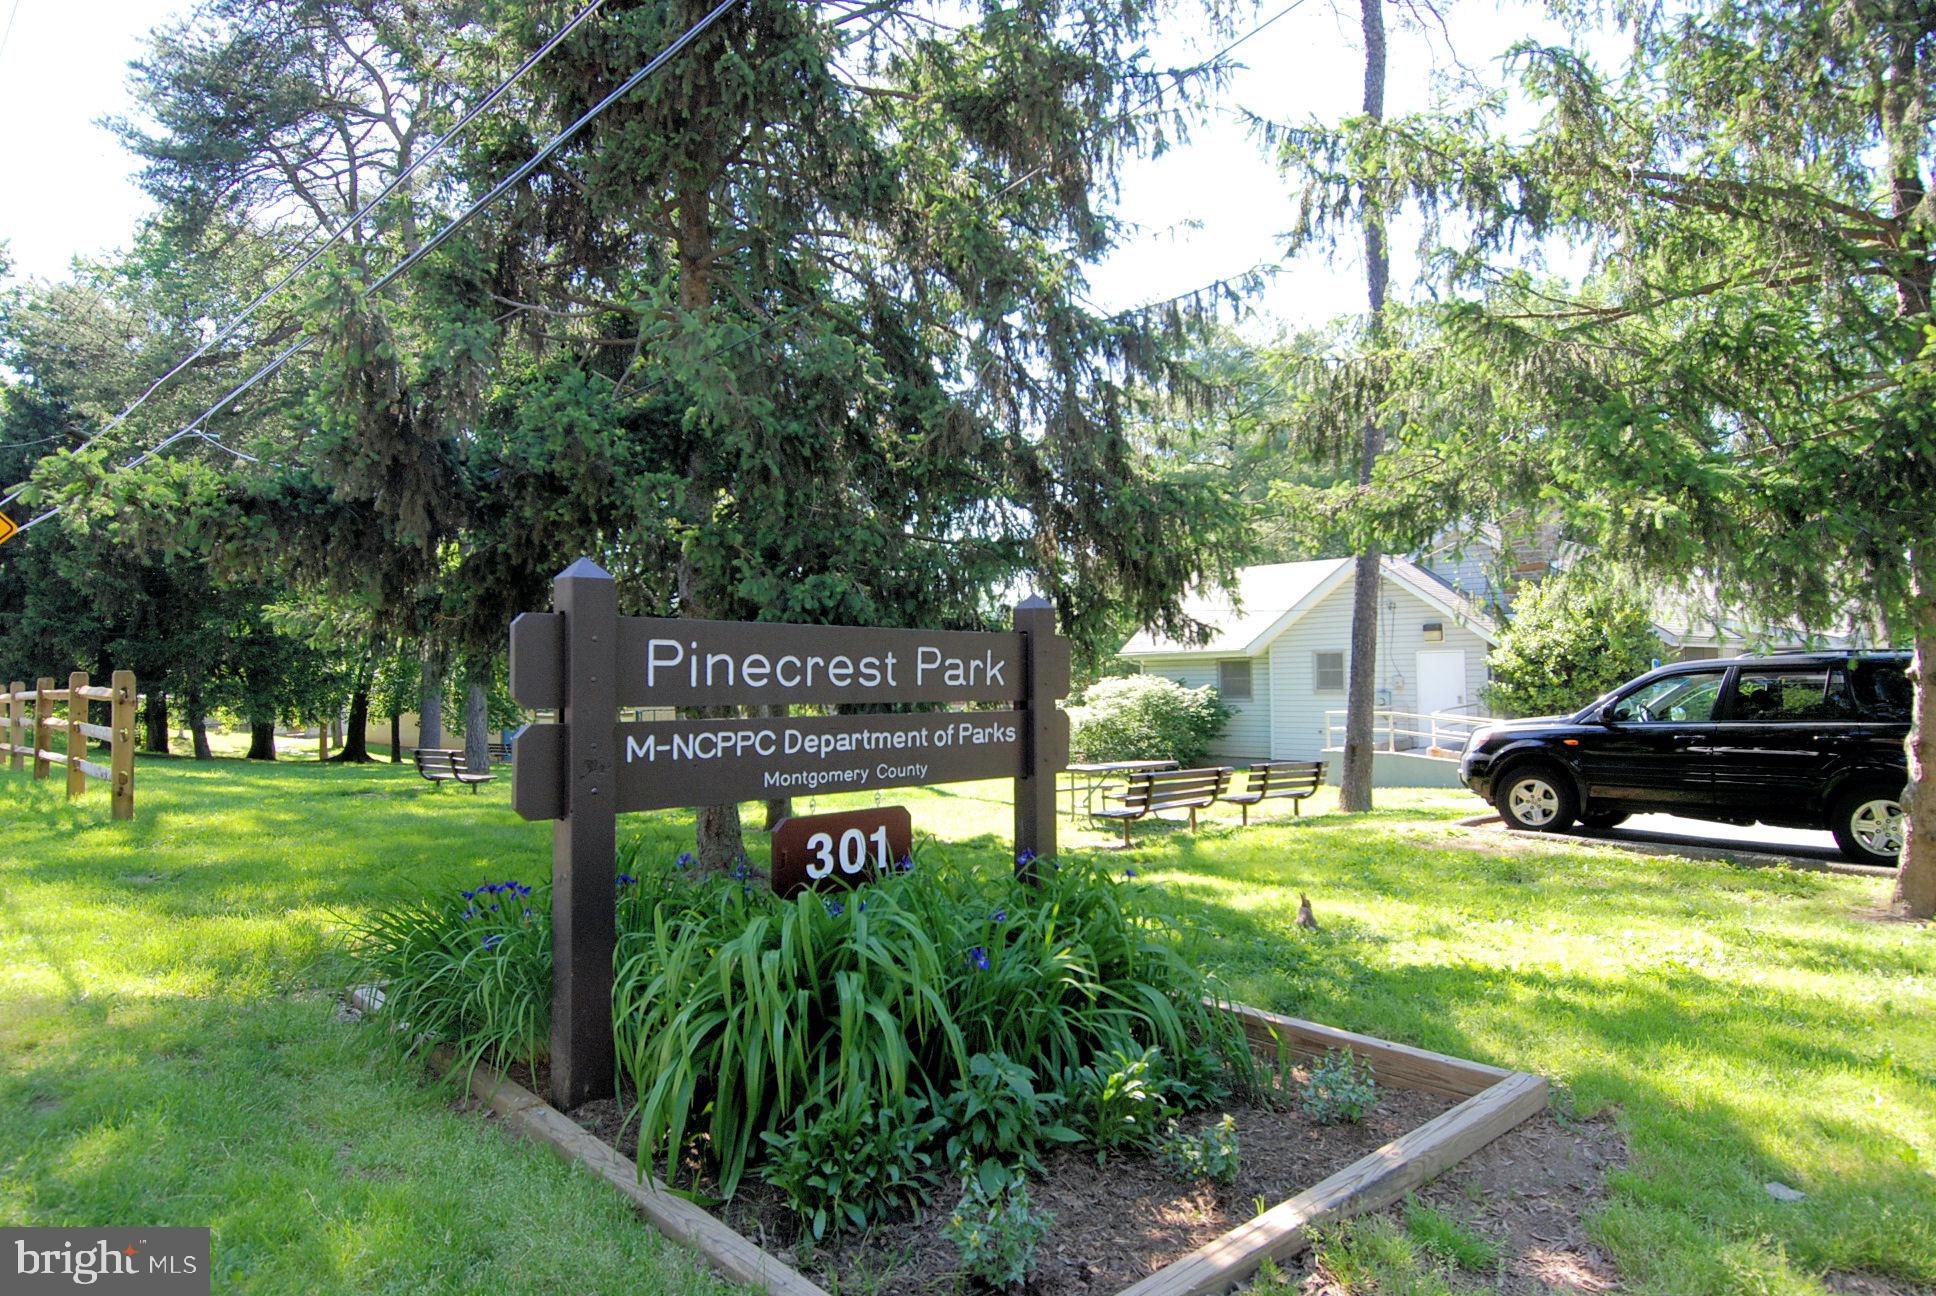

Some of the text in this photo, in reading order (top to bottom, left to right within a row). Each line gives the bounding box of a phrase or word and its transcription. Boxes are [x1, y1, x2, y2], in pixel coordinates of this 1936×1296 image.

[647, 638, 1006, 688] Pinecrest Park
[626, 722, 1017, 763] M-NCPPC Department of Parks
[764, 763, 928, 788] Montgomery County
[805, 825, 889, 880] 301
